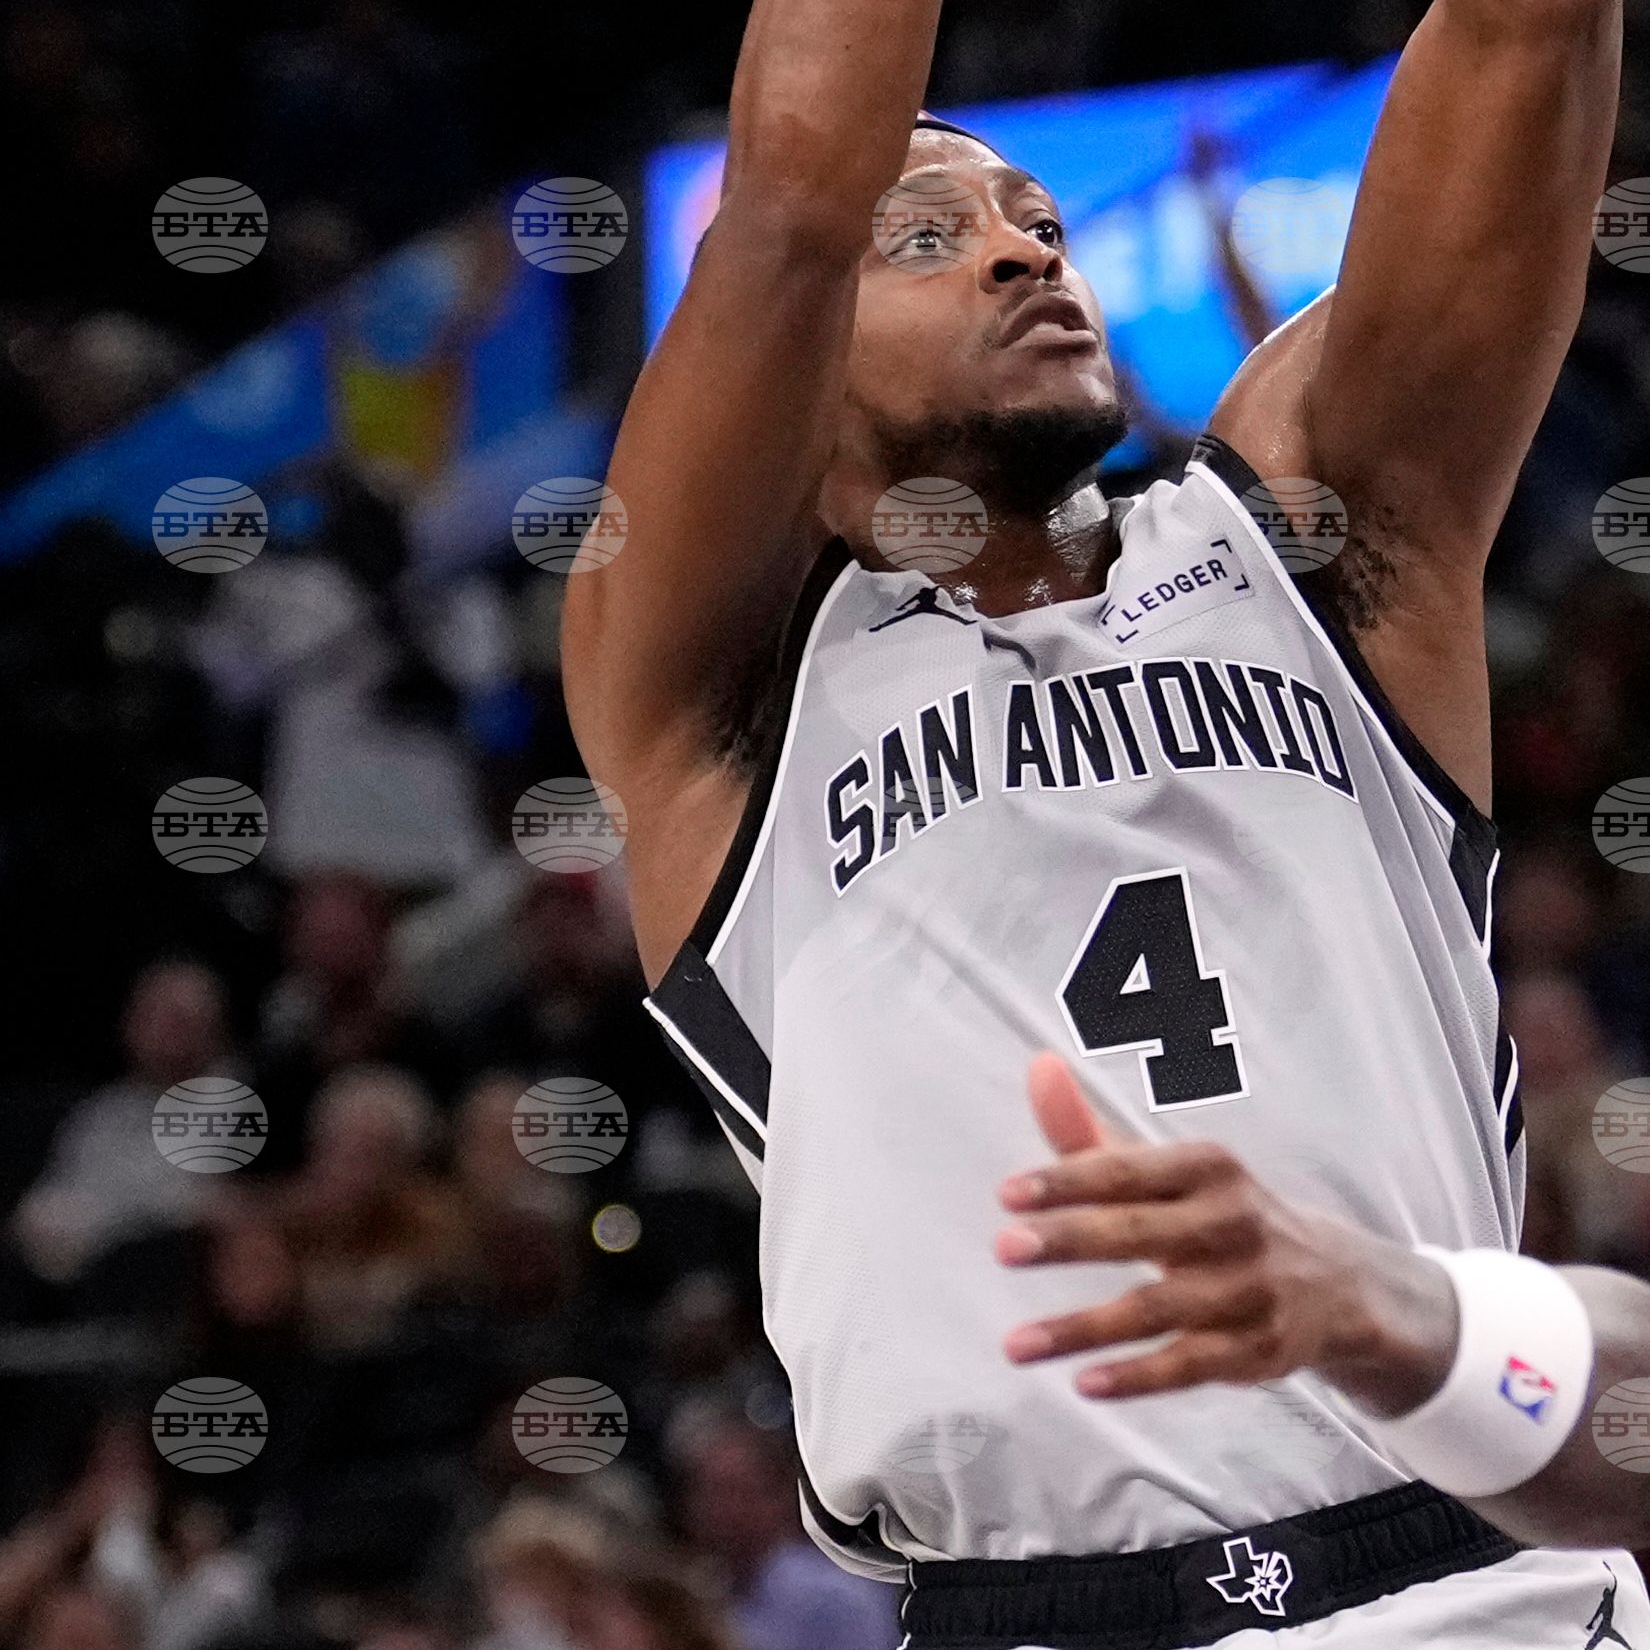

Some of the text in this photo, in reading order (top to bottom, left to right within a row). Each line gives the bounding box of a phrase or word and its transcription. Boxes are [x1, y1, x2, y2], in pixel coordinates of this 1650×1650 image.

[1121, 559, 1227, 622] LEDGER
[824, 657, 1359, 898] SAN ANTONIO
[1055, 866, 1251, 1113] 4
